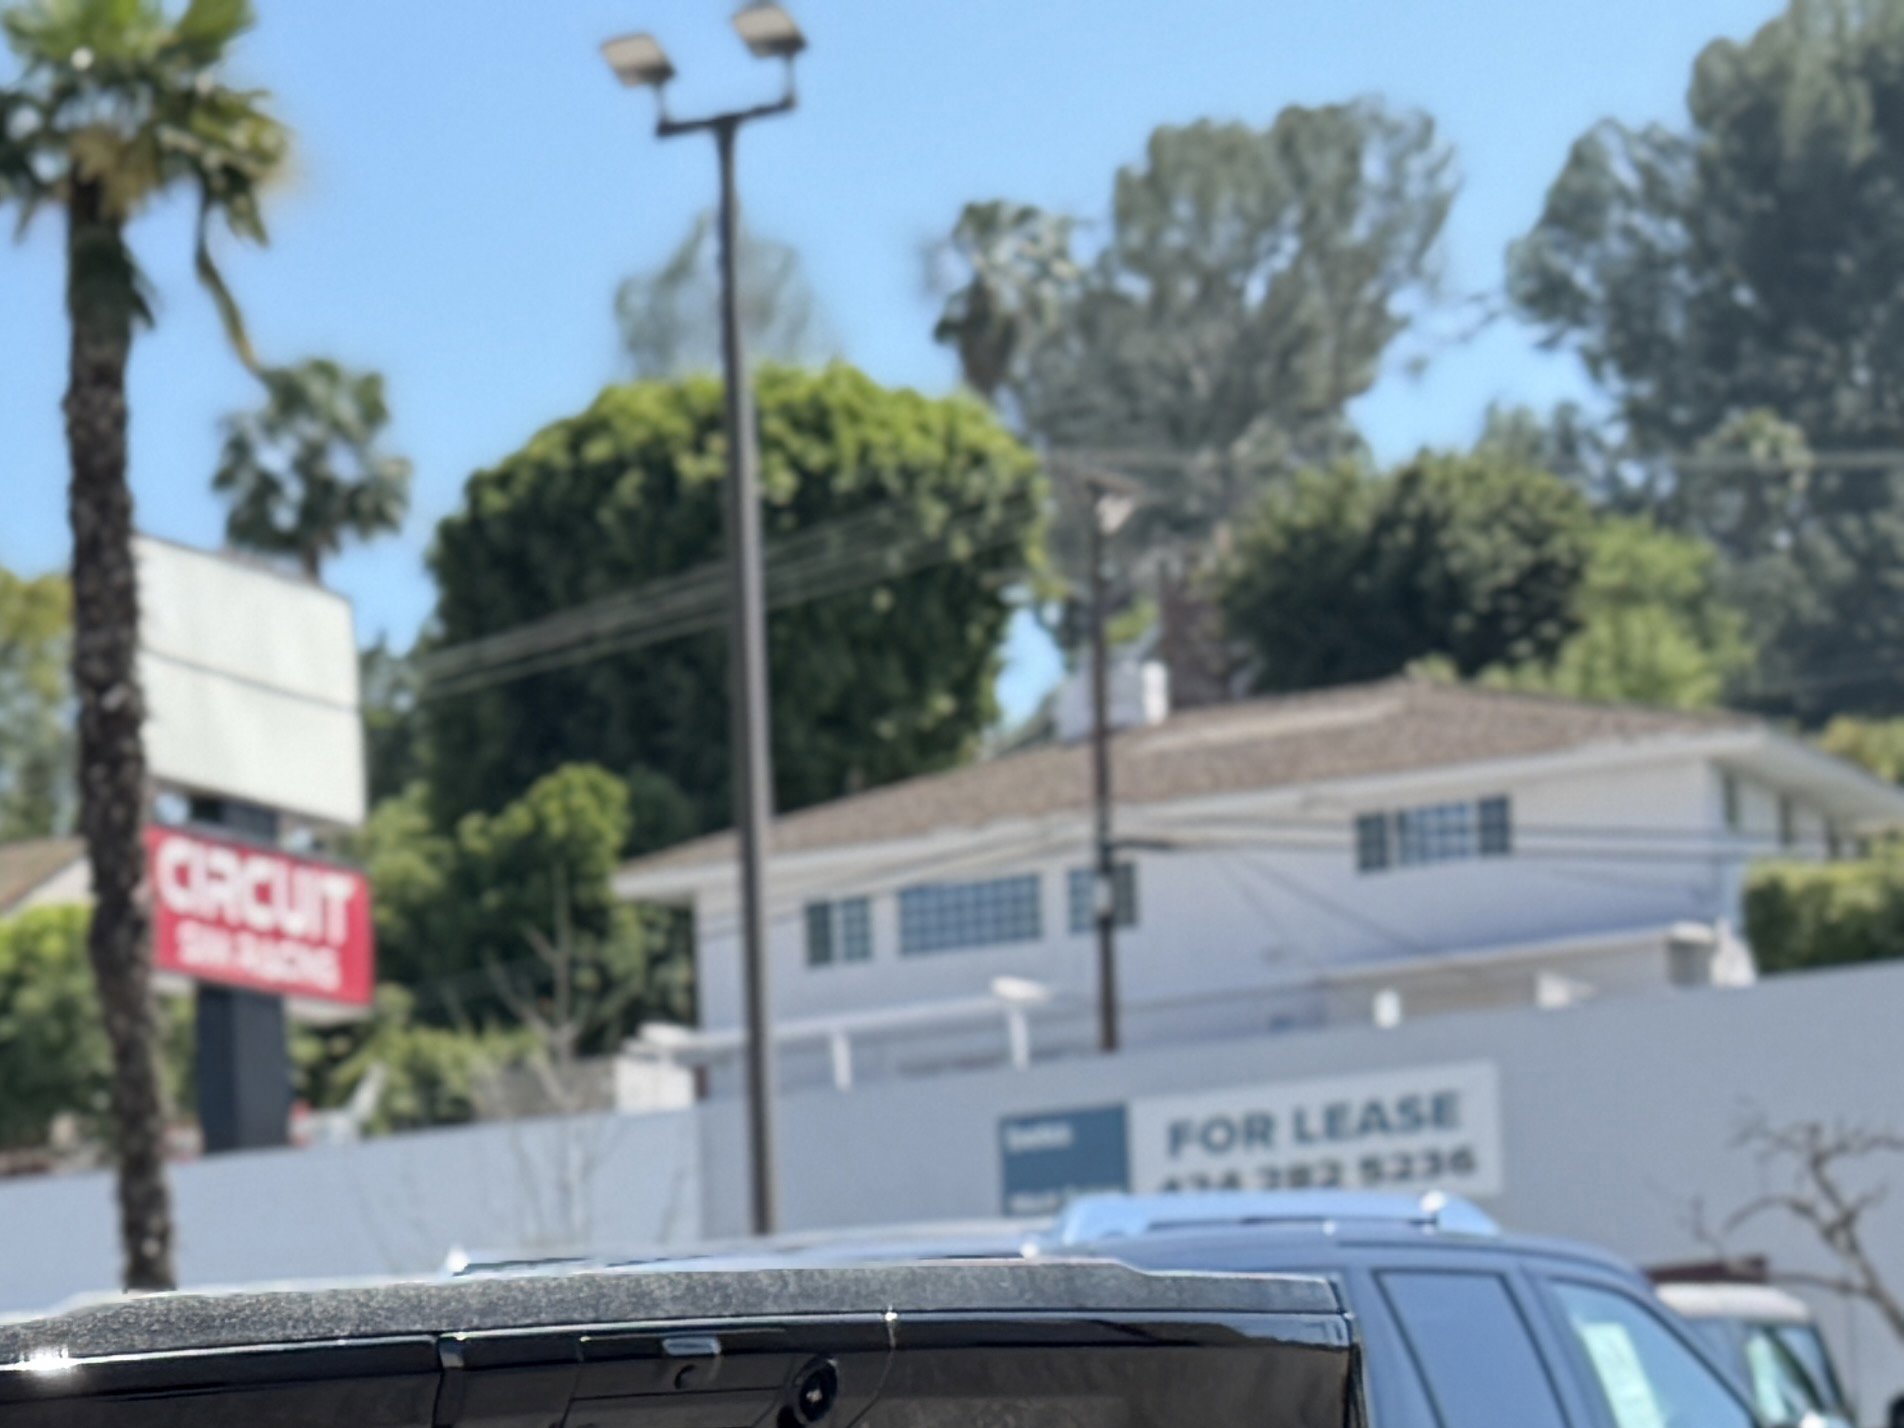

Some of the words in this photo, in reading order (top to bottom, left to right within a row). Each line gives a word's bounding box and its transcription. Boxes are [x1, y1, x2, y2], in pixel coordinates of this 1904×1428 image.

[155, 836, 355, 947] CIRCUIT
[1166, 1110, 1276, 1158] FOR
[1292, 1090, 1460, 1145] LEASE
